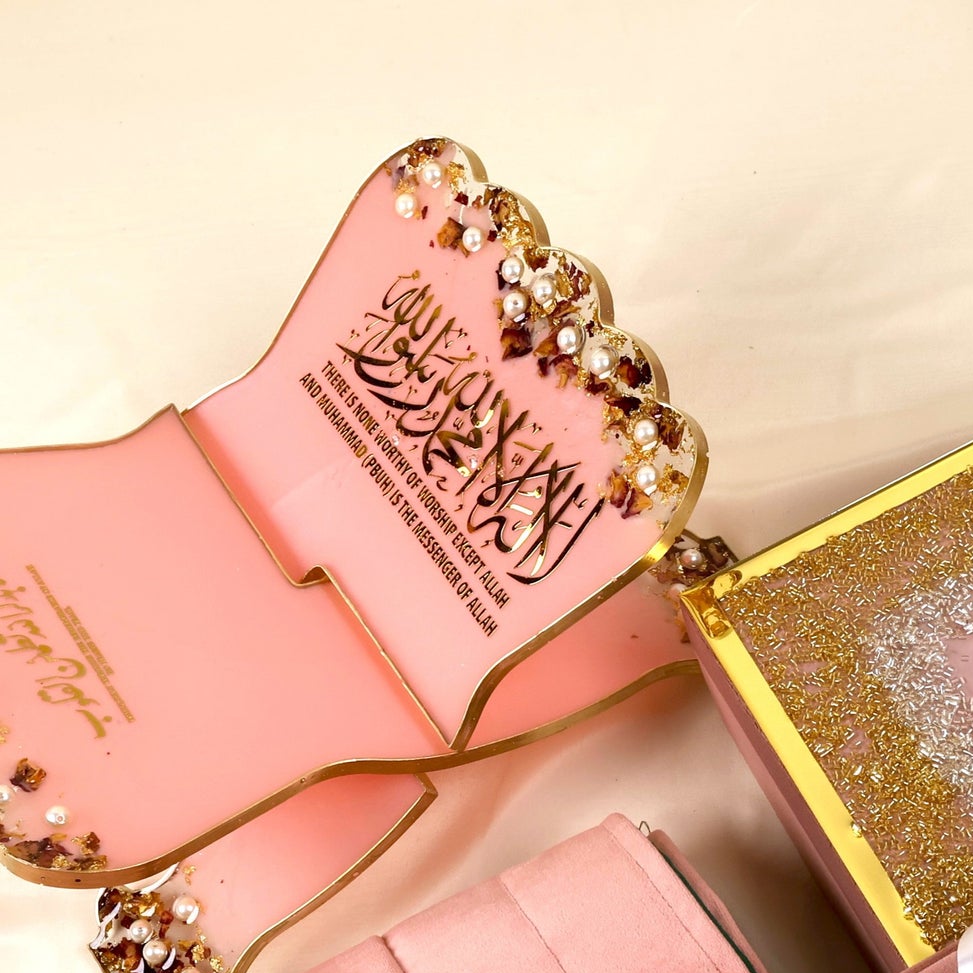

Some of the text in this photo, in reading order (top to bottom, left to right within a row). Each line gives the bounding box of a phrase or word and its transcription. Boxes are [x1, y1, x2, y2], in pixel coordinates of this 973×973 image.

[299, 373, 498, 637] AND MUHAMMAD (PBUH) IS THE MESSENGER OF ALLAH
[322, 360, 510, 609] THERE IS NONE WORTHY OF WORSHIP EXCEPT ALLAH
